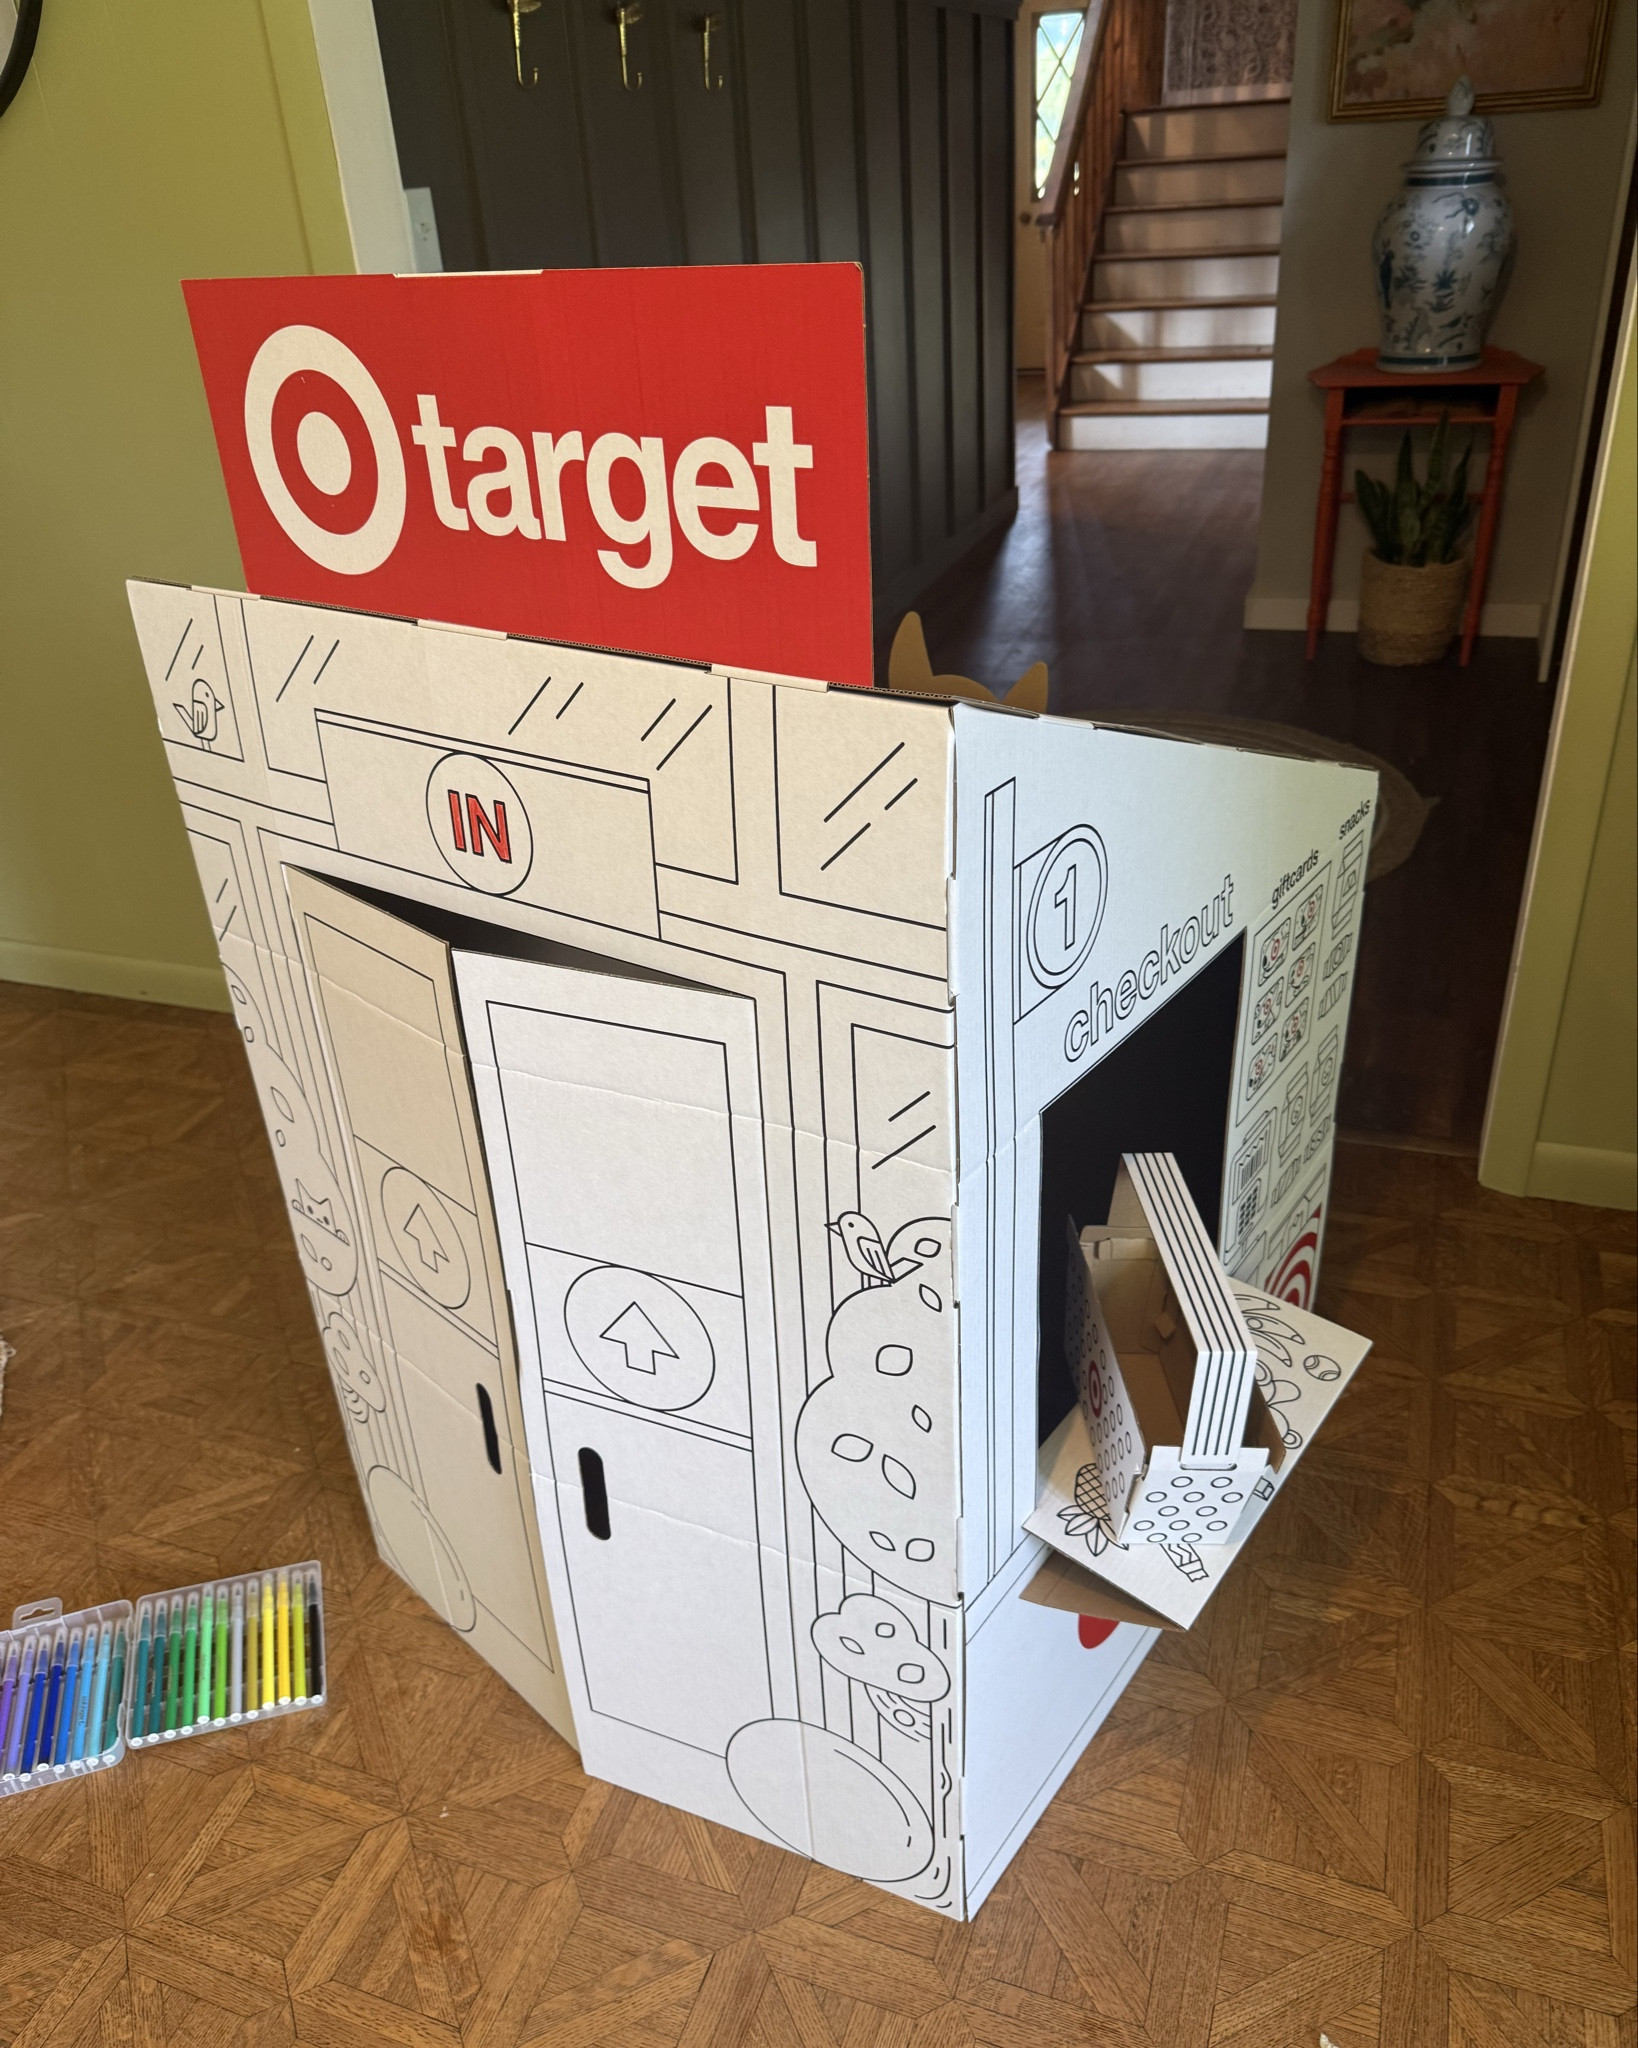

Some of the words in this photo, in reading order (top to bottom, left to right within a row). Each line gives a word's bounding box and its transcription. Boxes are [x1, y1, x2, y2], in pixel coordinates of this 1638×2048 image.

[411, 394, 817, 589] target
[447, 789, 513, 864] IN
[1338, 799, 1371, 841] snacks
[1054, 863, 1077, 951] 1
[1271, 848, 1319, 910] giftcards
[1064, 873, 1235, 1063] checkout
